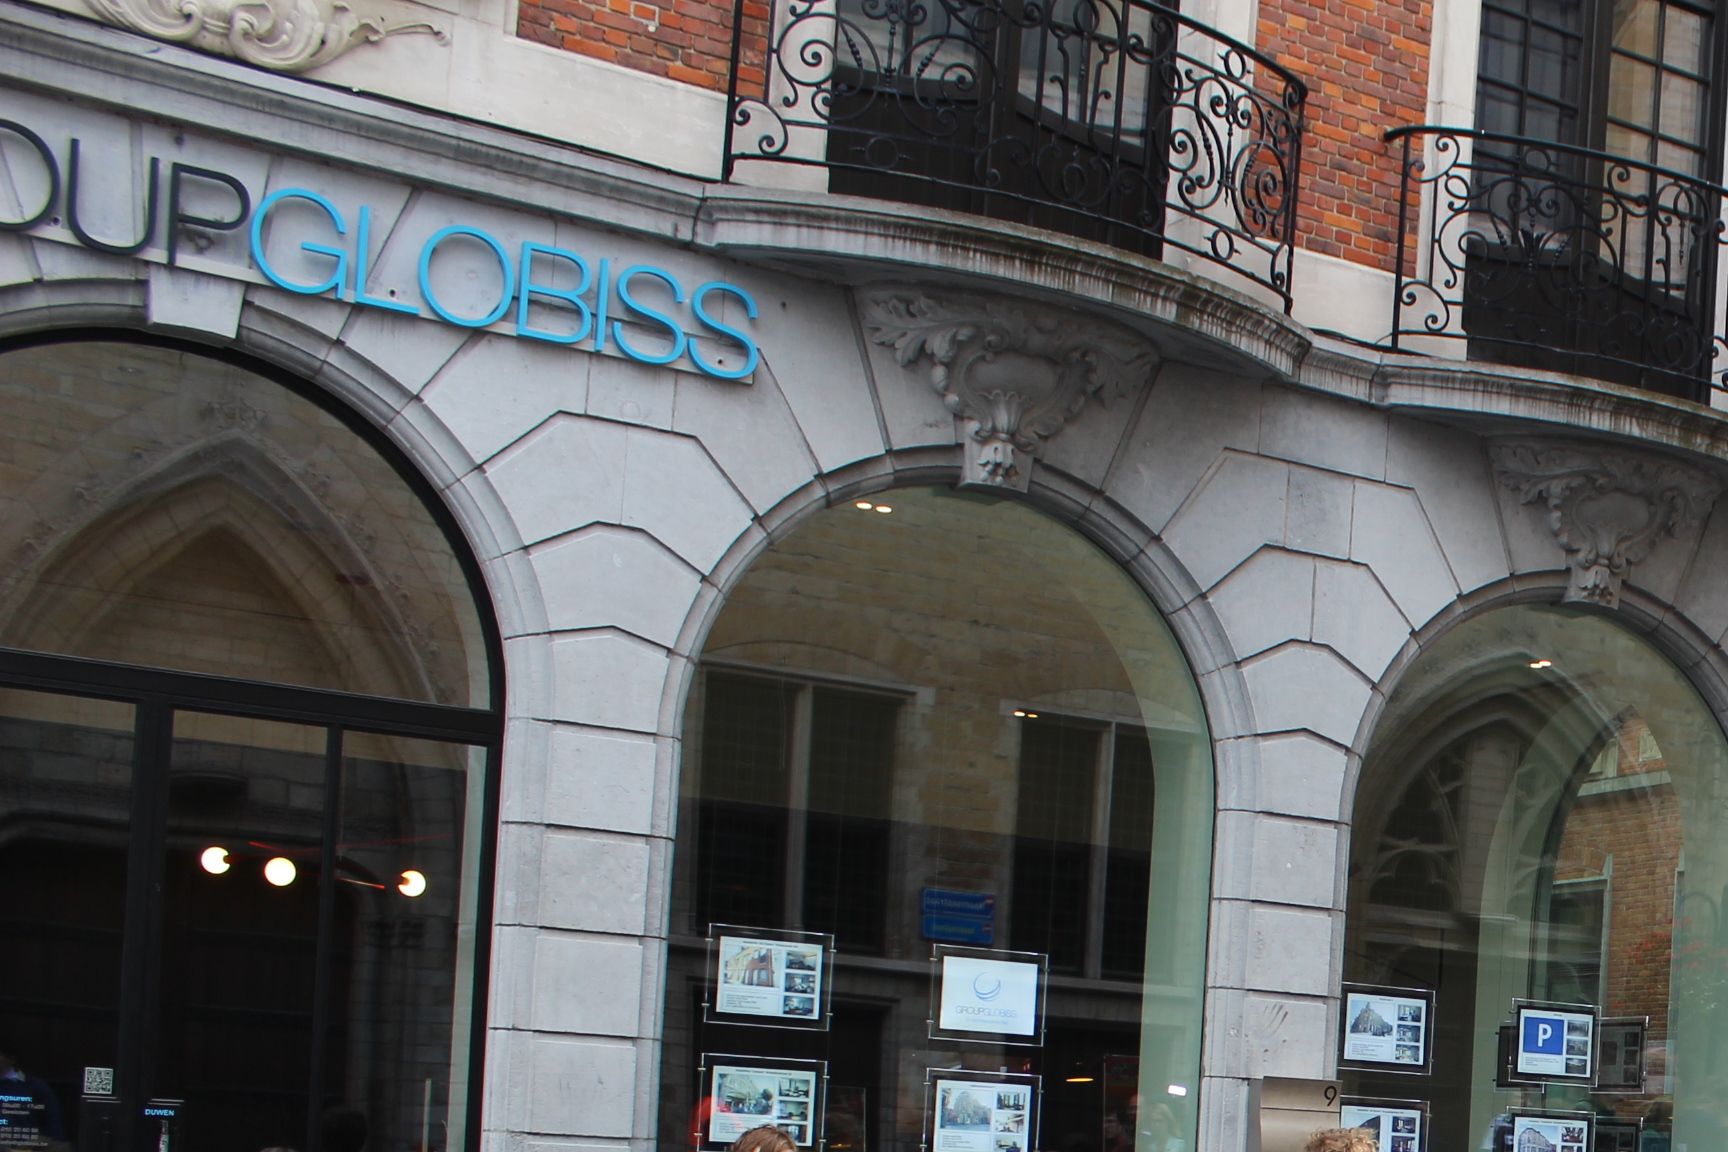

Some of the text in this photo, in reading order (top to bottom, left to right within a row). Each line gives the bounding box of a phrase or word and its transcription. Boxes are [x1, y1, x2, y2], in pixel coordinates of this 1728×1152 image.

[1537, 1023, 1553, 1047] P
[1323, 1085, 1338, 1107] 9
[144, 1108, 175, 1116] DUWEN
